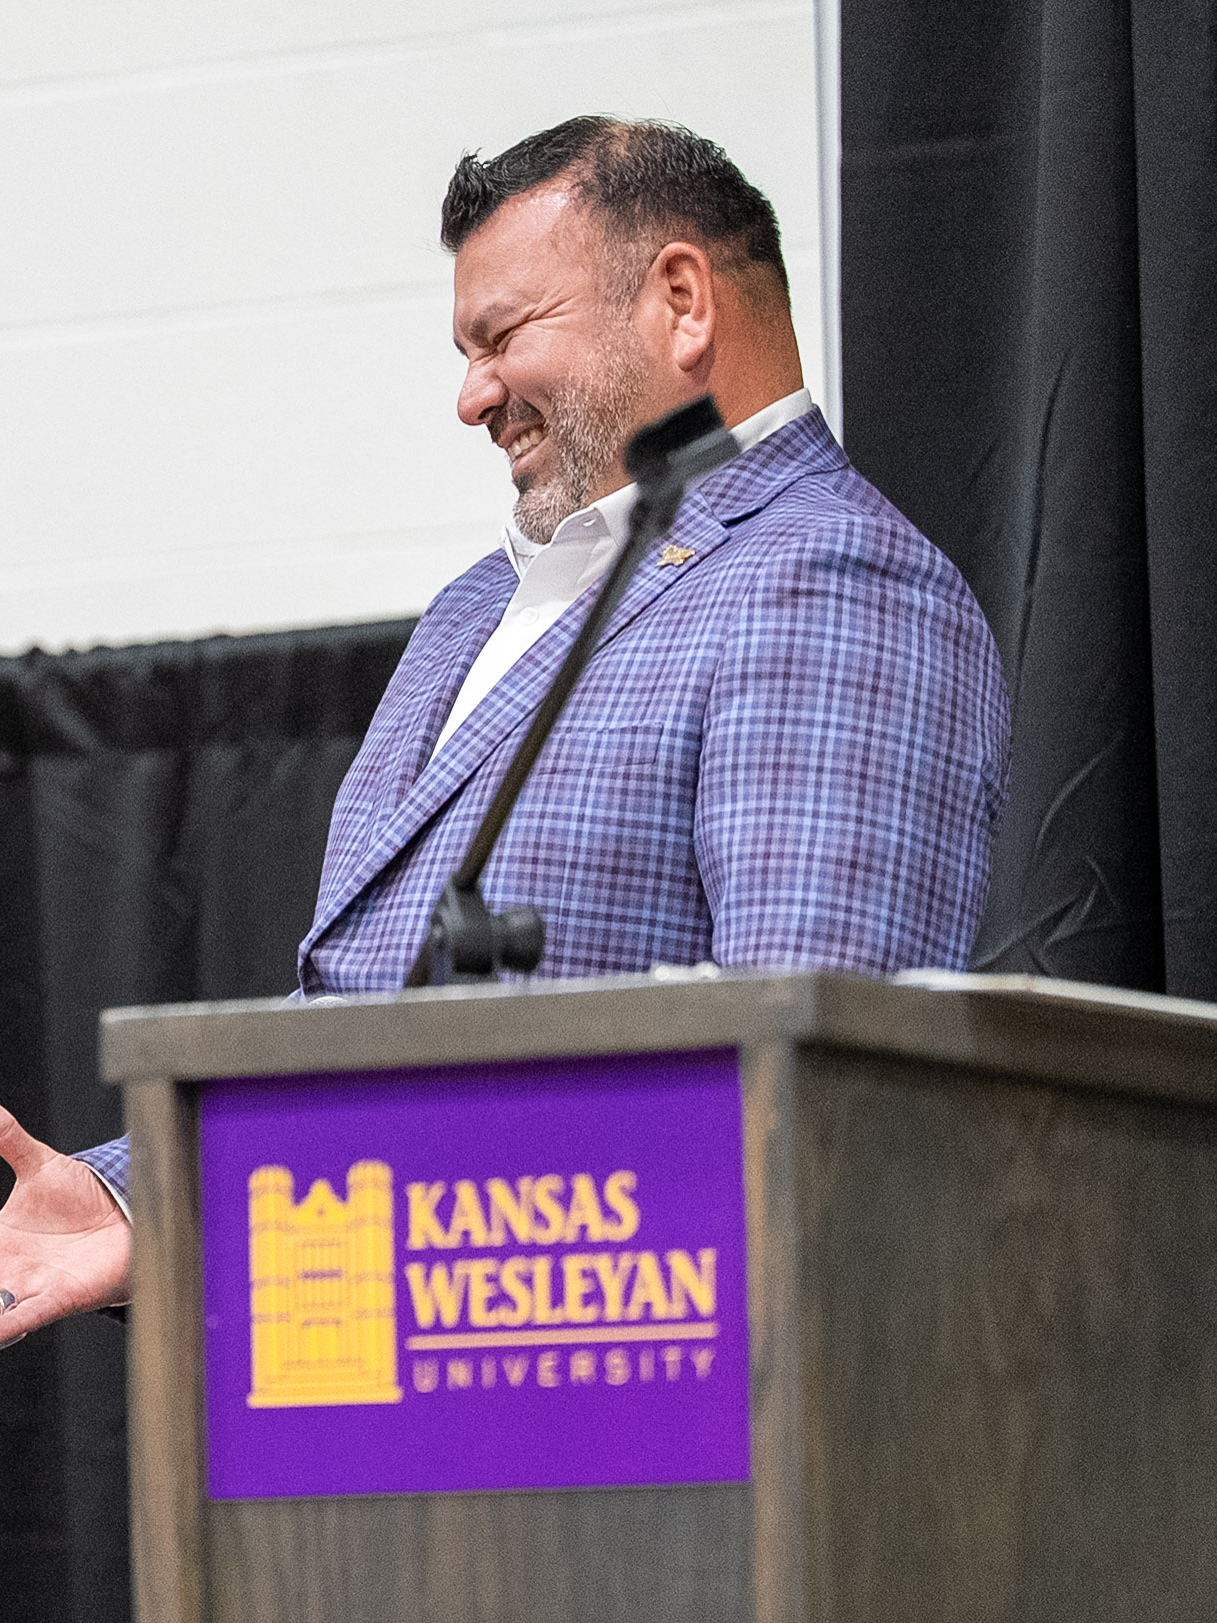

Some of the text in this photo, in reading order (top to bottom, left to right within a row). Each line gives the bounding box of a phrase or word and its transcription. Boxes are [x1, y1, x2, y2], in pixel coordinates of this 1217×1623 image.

[406, 1170, 640, 1249] KANSAS
[405, 1248, 717, 1329] WESLEYAN
[412, 1346, 716, 1393] UNIVERSITY
